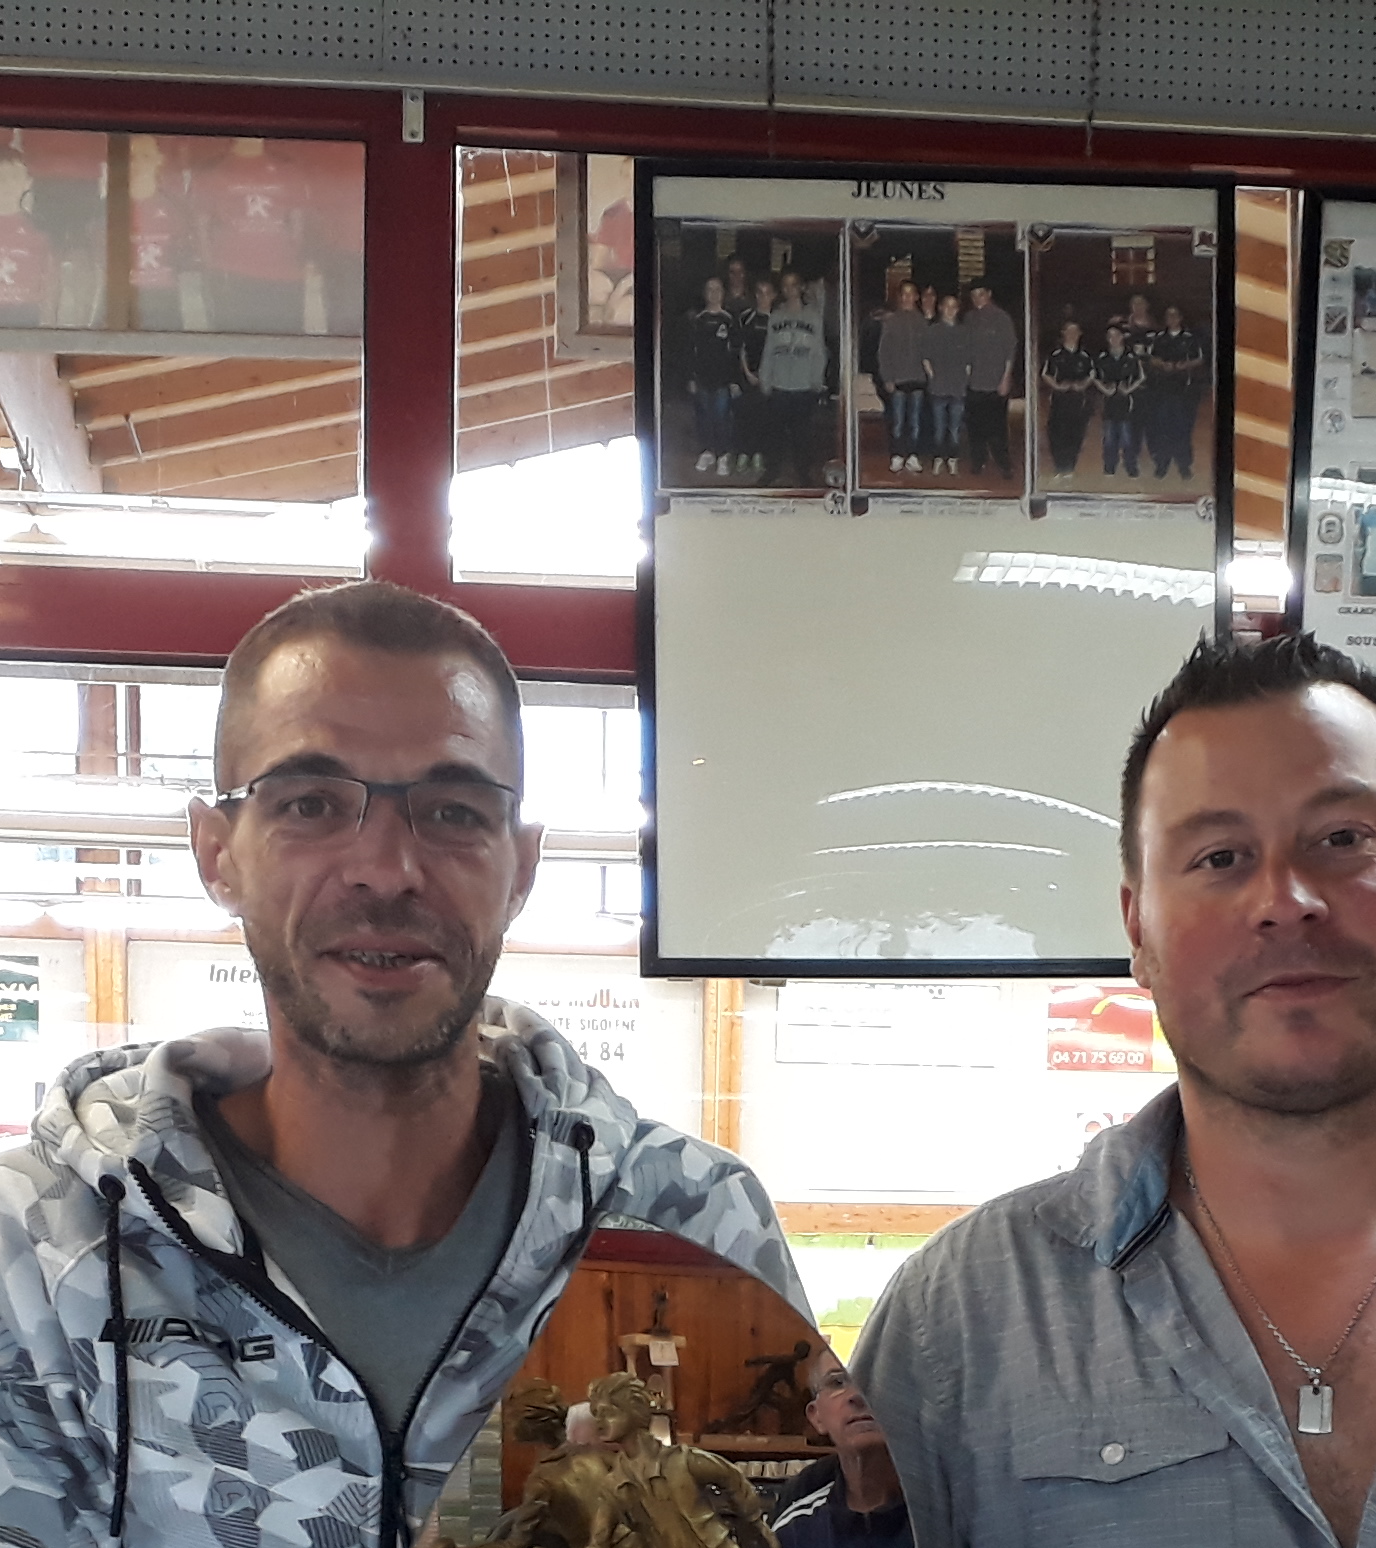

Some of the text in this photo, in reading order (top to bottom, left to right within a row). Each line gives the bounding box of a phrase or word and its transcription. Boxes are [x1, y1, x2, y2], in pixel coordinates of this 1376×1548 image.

[851, 180, 945, 200] JEUNES
[599, 1041, 625, 1062] 84
[1052, 1051, 1070, 1064] 04
[1073, 1051, 1088, 1064] 71
[1091, 1051, 1107, 1064] 75
